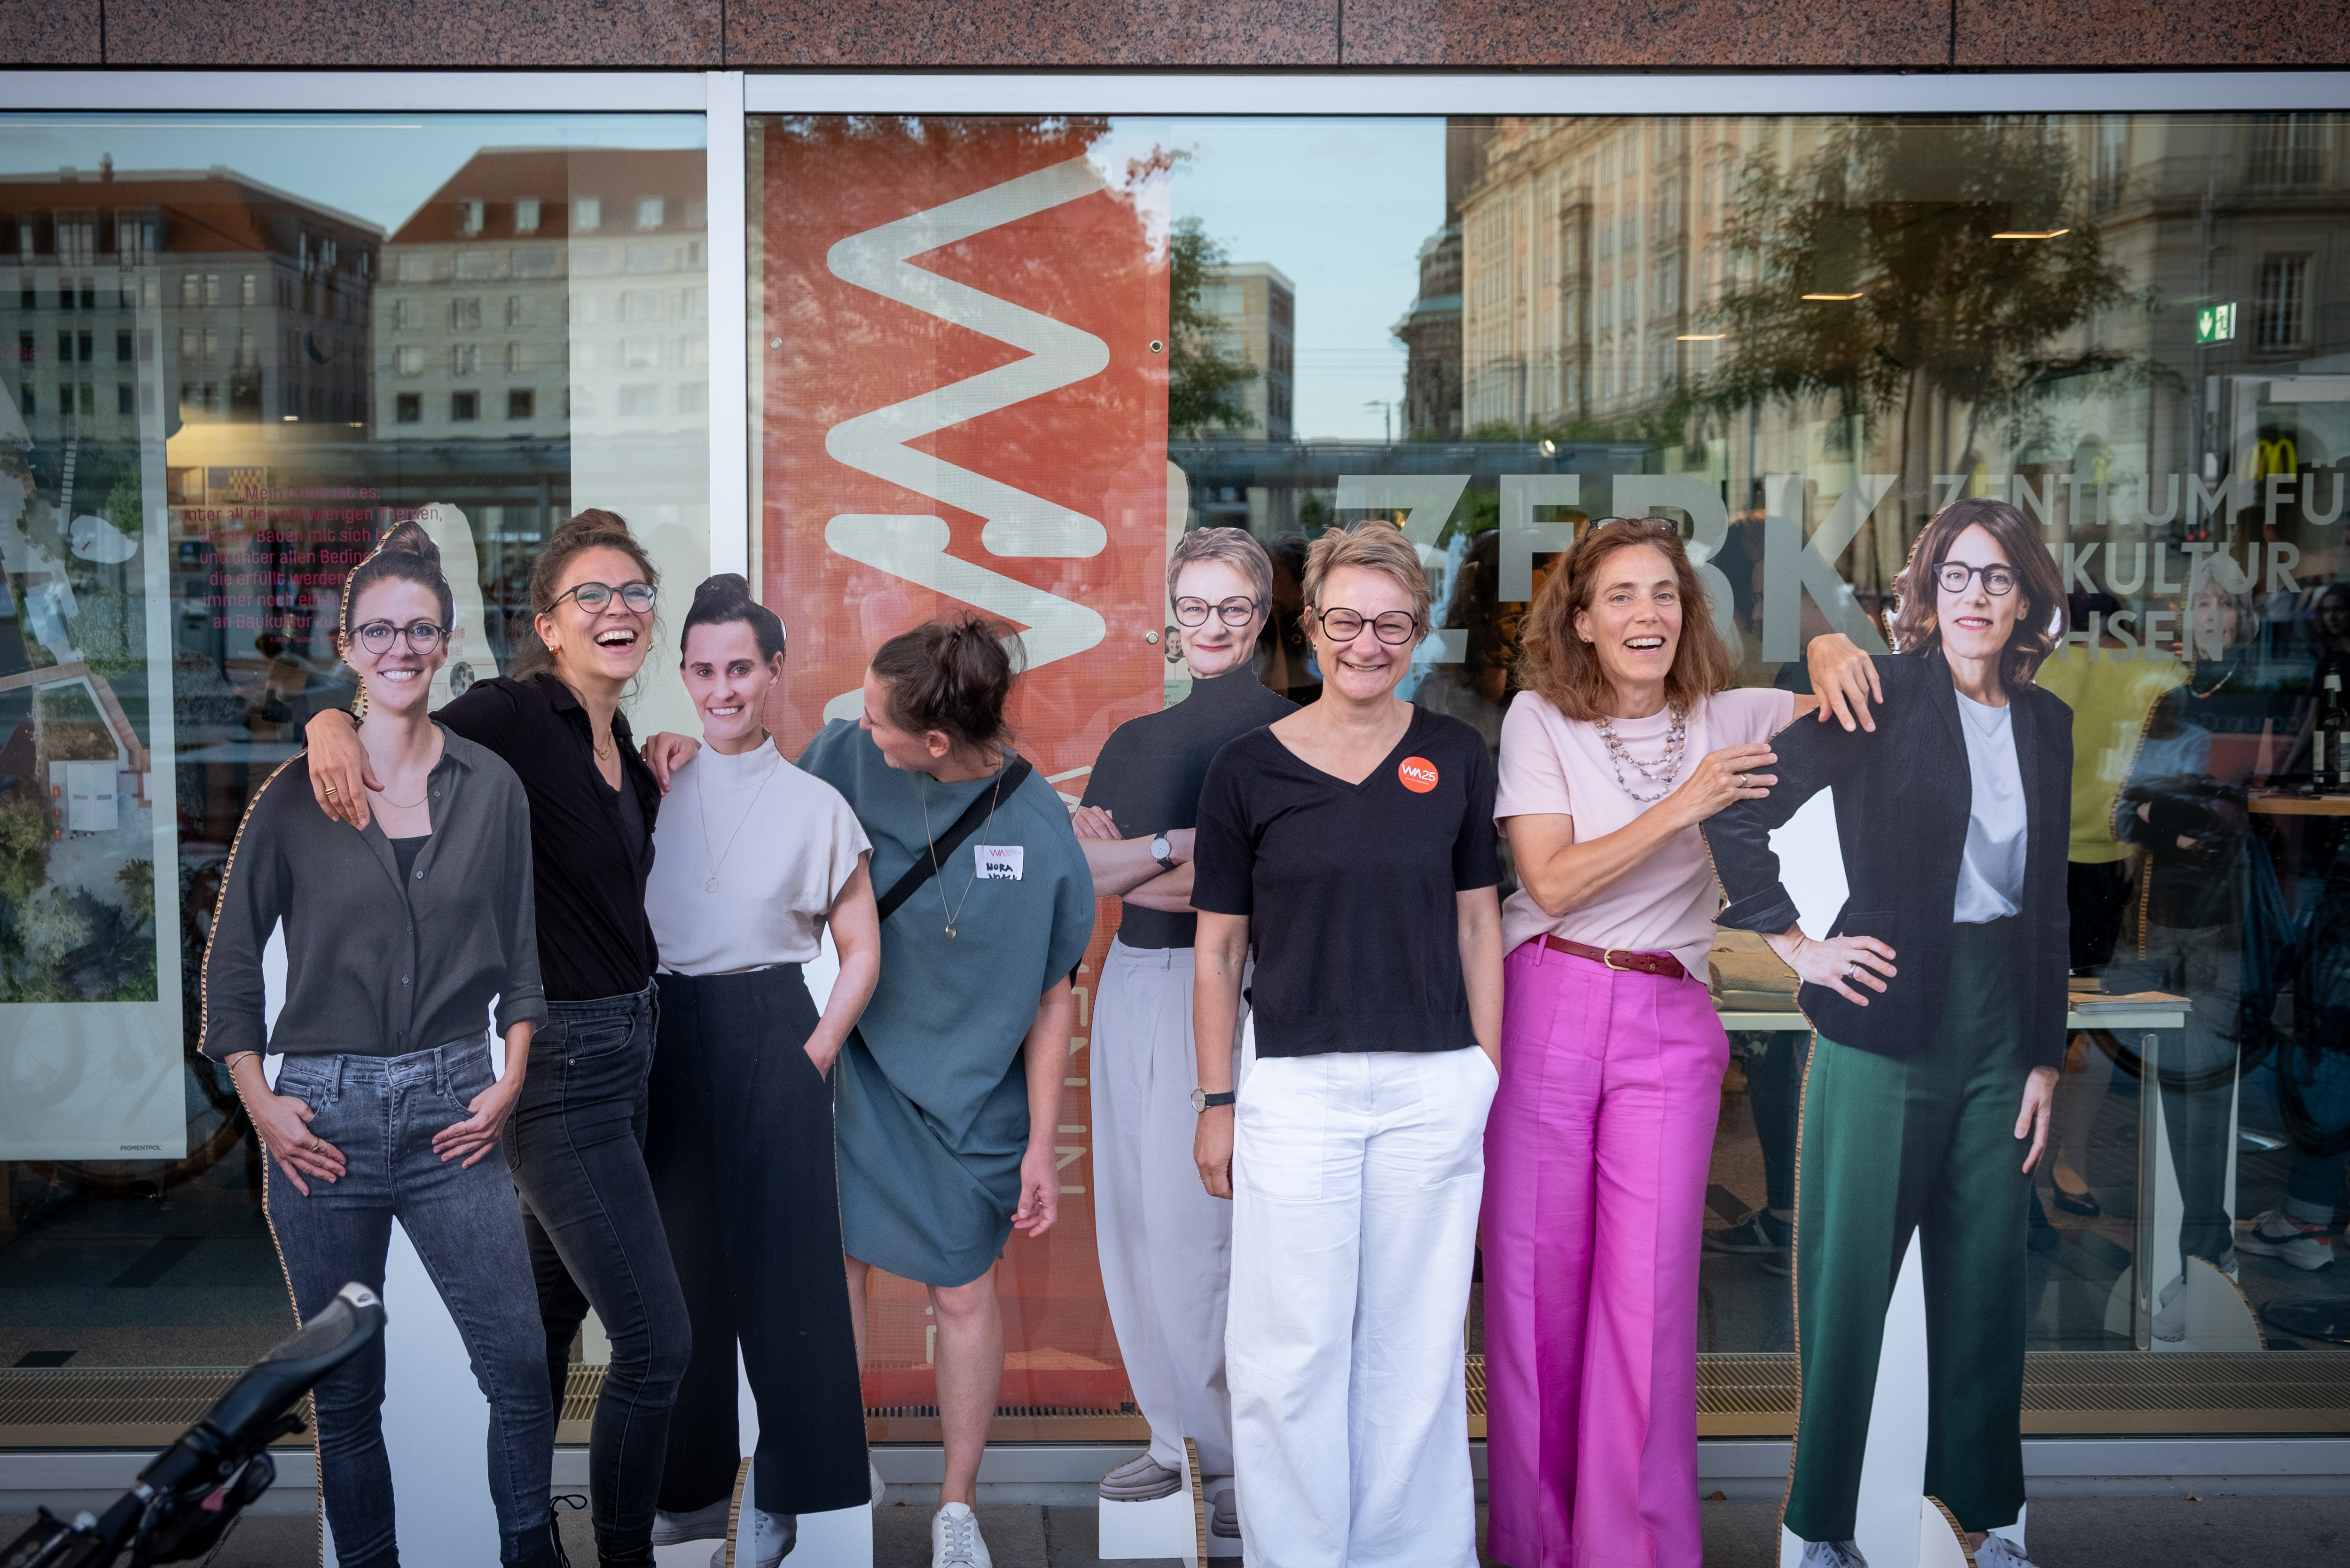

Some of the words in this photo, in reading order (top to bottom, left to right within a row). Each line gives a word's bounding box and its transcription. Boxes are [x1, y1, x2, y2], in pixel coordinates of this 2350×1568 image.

[334, 486, 355, 499] ist
[360, 487, 380, 499] es:
[2264, 458, 2344, 525] FÜ
[227, 507, 243, 521] all
[248, 506, 275, 521] den
[280, 506, 373, 524] schwierigen
[257, 529, 303, 543] Bauen
[308, 527, 335, 542] mit
[340, 527, 371, 542] sich
[200, 551, 227, 564] und
[233, 550, 275, 564] unter
[279, 549, 315, 564] allen
[2047, 542, 2302, 595] KULTUR
[210, 571, 232, 585] die
[237, 571, 285, 585] erfüllt
[290, 571, 346, 585] werden
[203, 593, 253, 607] immer
[258, 592, 294, 607] noch
[299, 592, 339, 606] einen
[213, 616, 231, 628] an
[236, 614, 312, 628] Baukultur
[316, 616, 333, 628] zu
[2059, 611, 2224, 663] HSEN
[1402, 763, 1436, 782] WA25
[986, 862, 1013, 872] NORA
